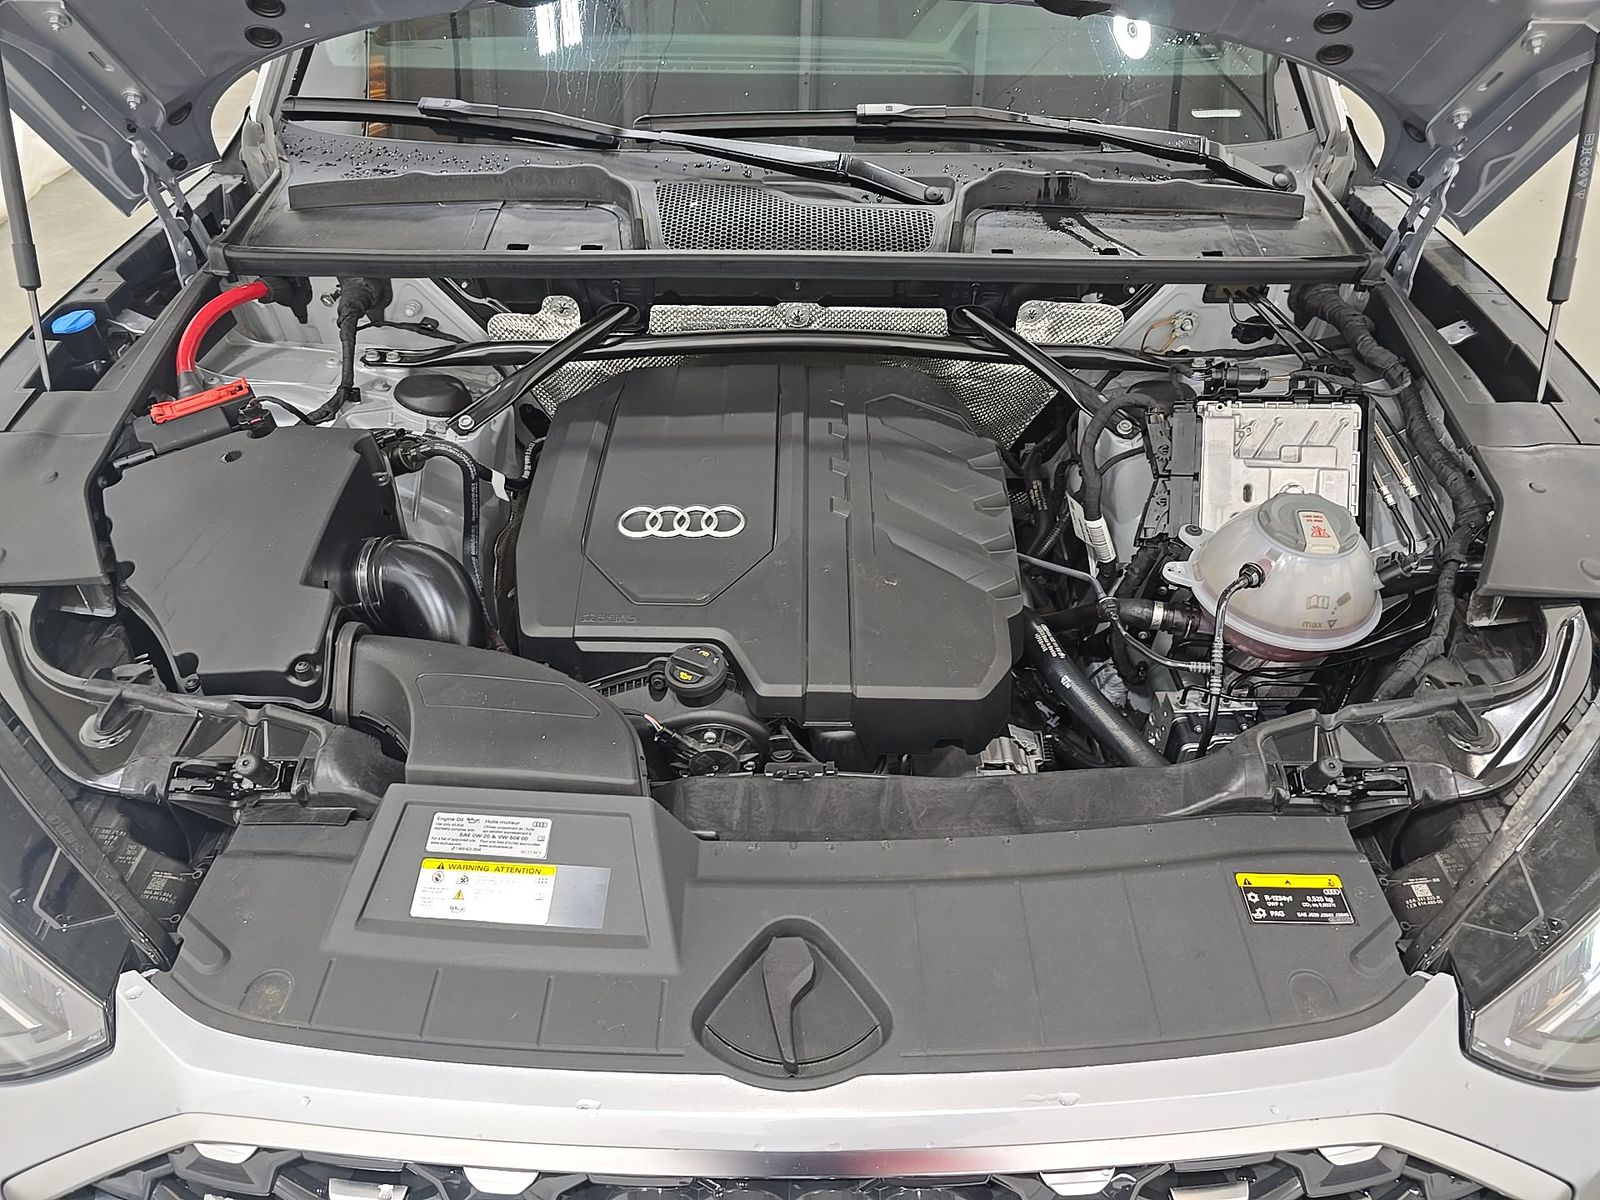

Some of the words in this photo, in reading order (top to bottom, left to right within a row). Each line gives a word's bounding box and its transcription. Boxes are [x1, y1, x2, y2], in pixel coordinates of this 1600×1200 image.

[1302, 621, 1323, 629] max
[448, 864, 490, 872] WARNING
[494, 866, 542, 875] ATTENTION
